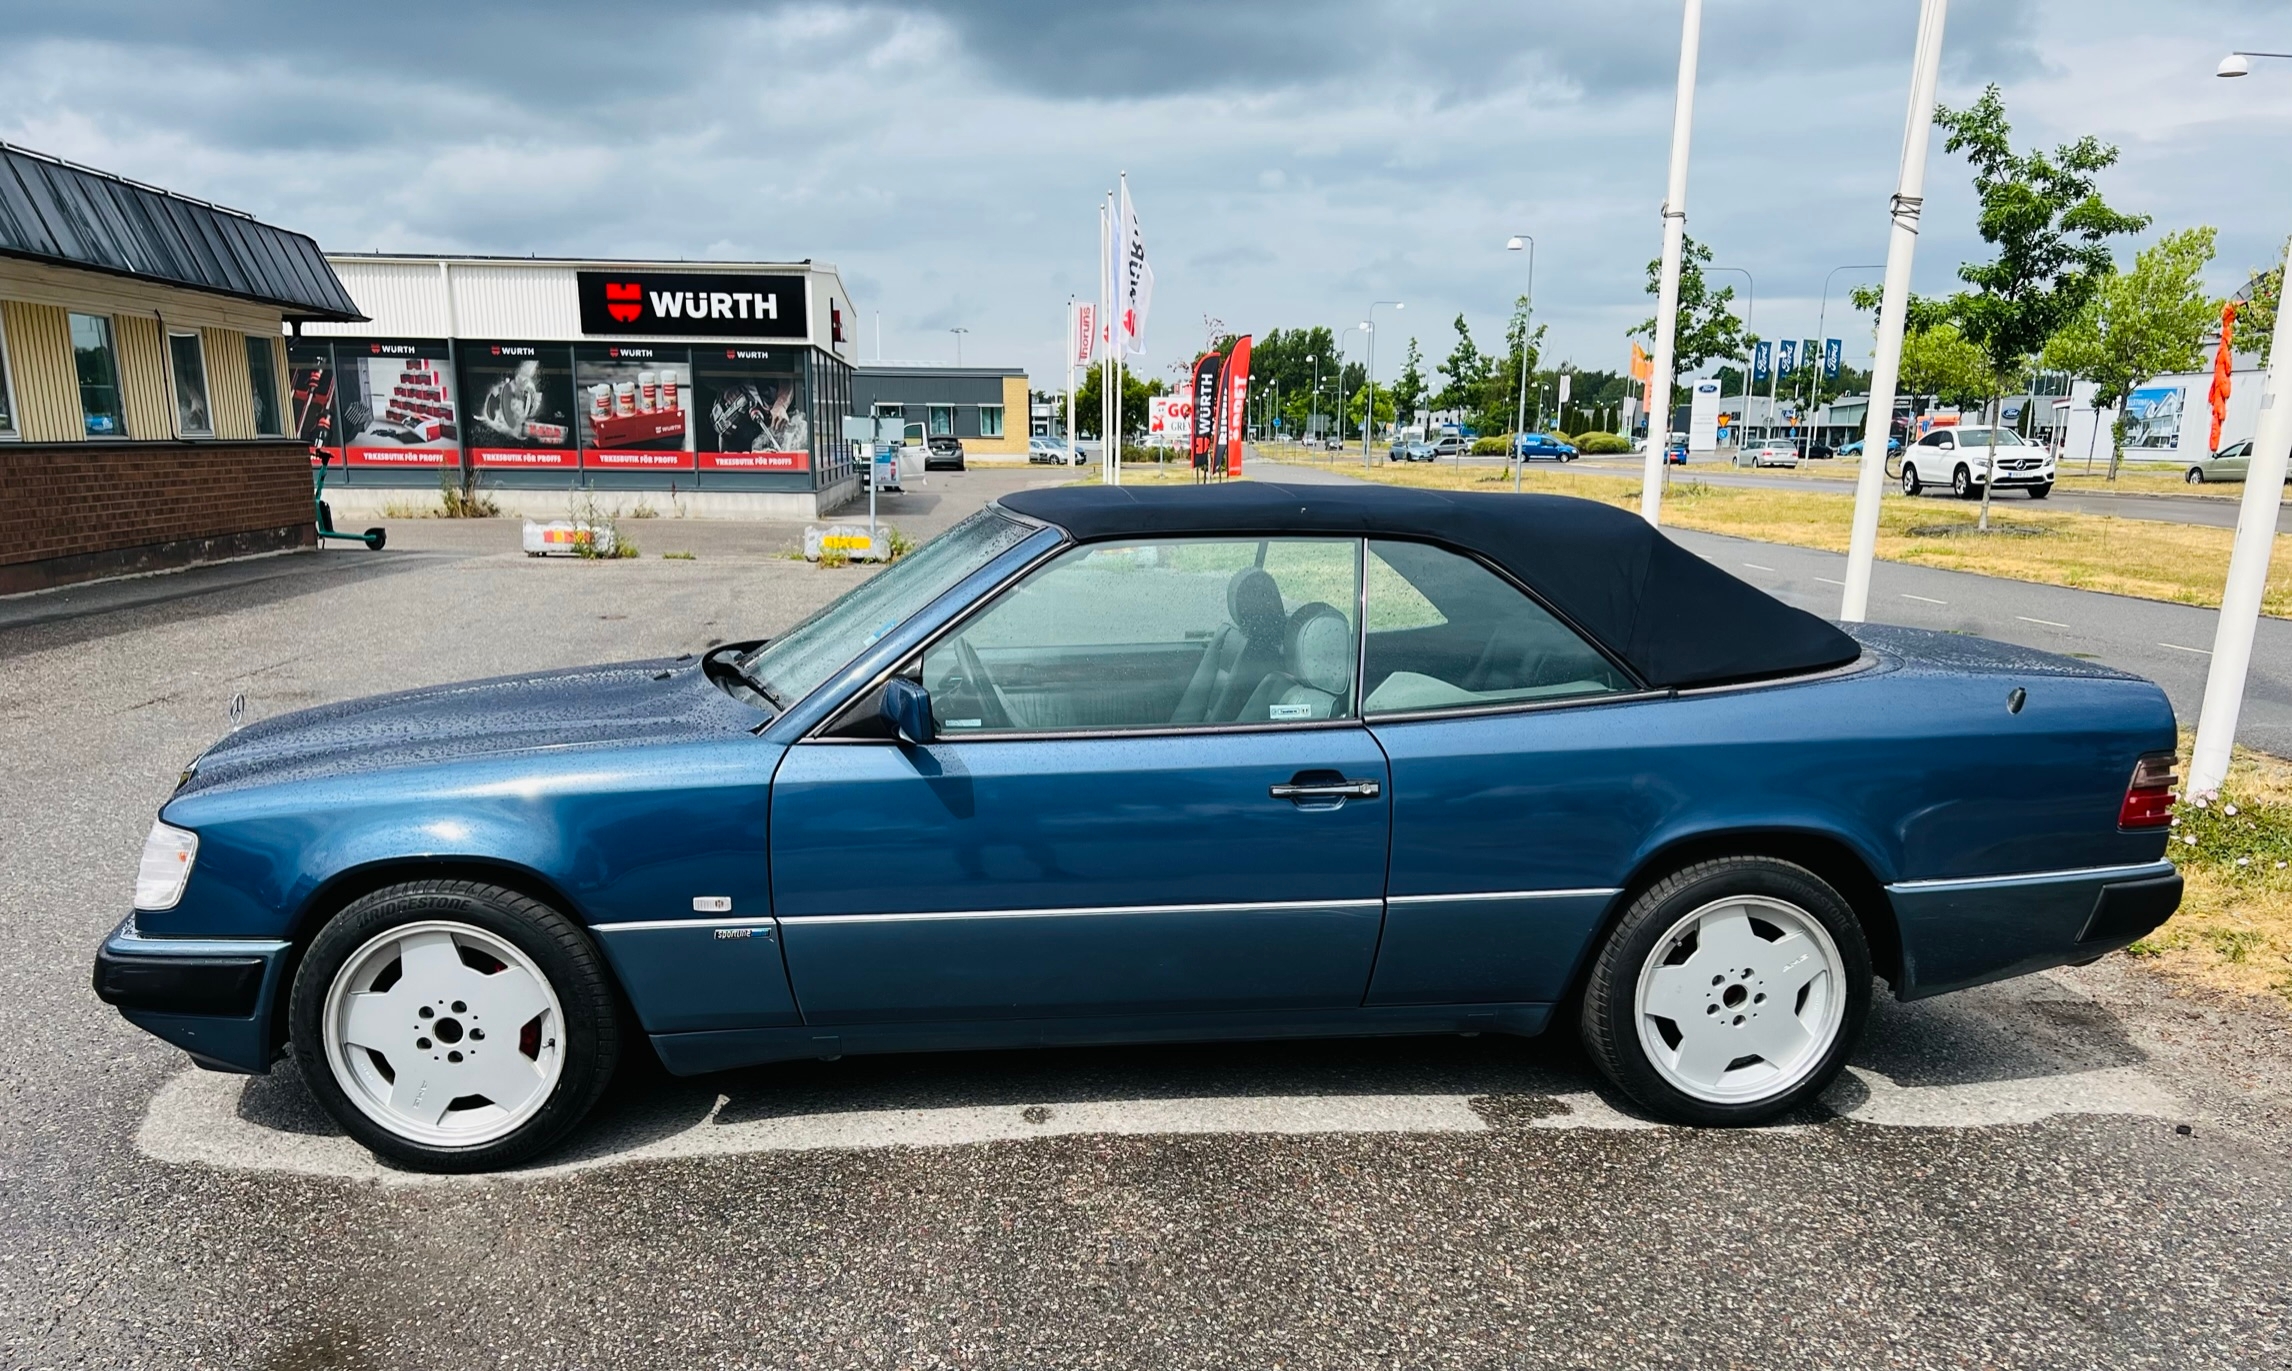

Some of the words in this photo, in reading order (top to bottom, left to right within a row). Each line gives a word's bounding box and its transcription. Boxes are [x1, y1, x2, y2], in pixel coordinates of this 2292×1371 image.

[649, 291, 778, 320] WÜRTH
[1079, 306, 1091, 360] Thoruns
[1756, 344, 1768, 373] Ford
[1781, 343, 1794, 373] Ford
[1827, 341, 1839, 372] Ford
[1198, 373, 1213, 435] WÜRTH
[405, 451, 418, 461] FÖR
[523, 452, 536, 462] FÖR
[640, 454, 653, 464] FÖR
[755, 456, 768, 466] FÖR
[357, 896, 473, 929] BRIDGESTONE
[717, 929, 751, 939] sportline
